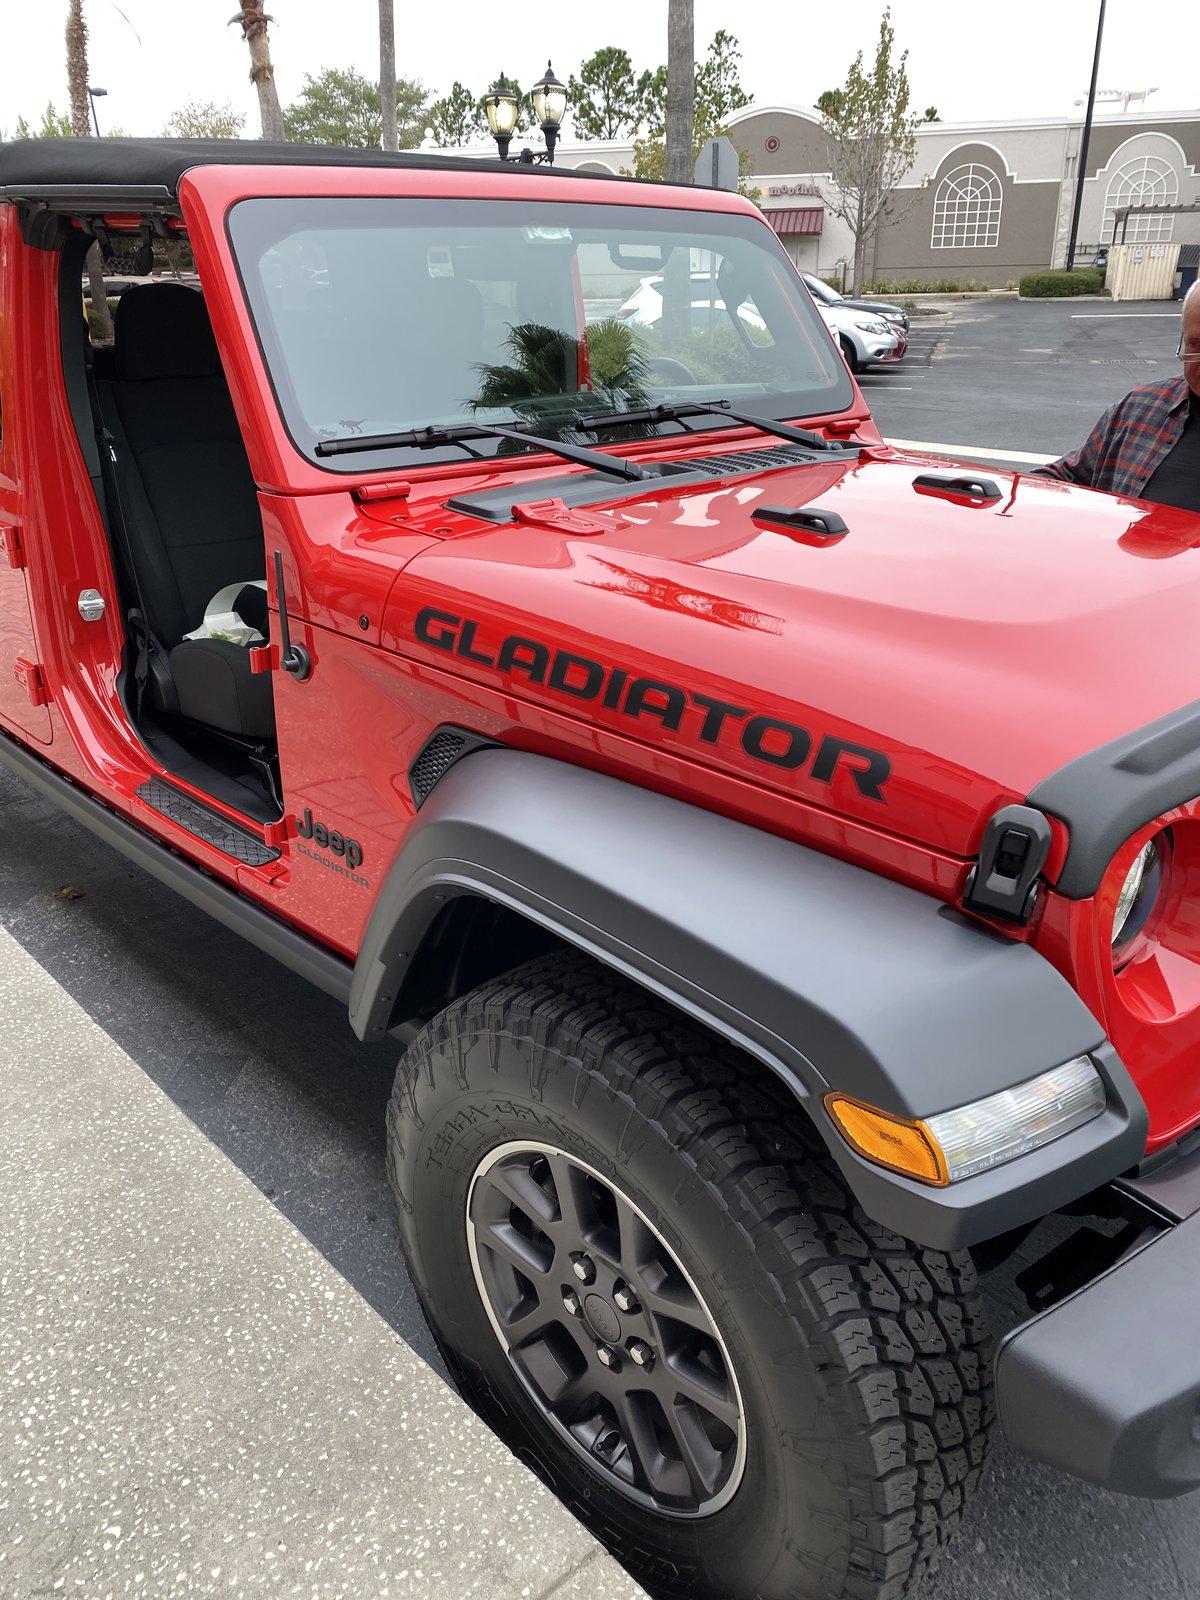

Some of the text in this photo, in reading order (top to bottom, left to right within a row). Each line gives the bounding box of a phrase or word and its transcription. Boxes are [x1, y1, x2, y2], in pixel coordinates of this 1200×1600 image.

[414, 607, 893, 804] GLADIATOR
[295, 807, 364, 870] Jeep
[296, 843, 370, 889] GLADIATOR
